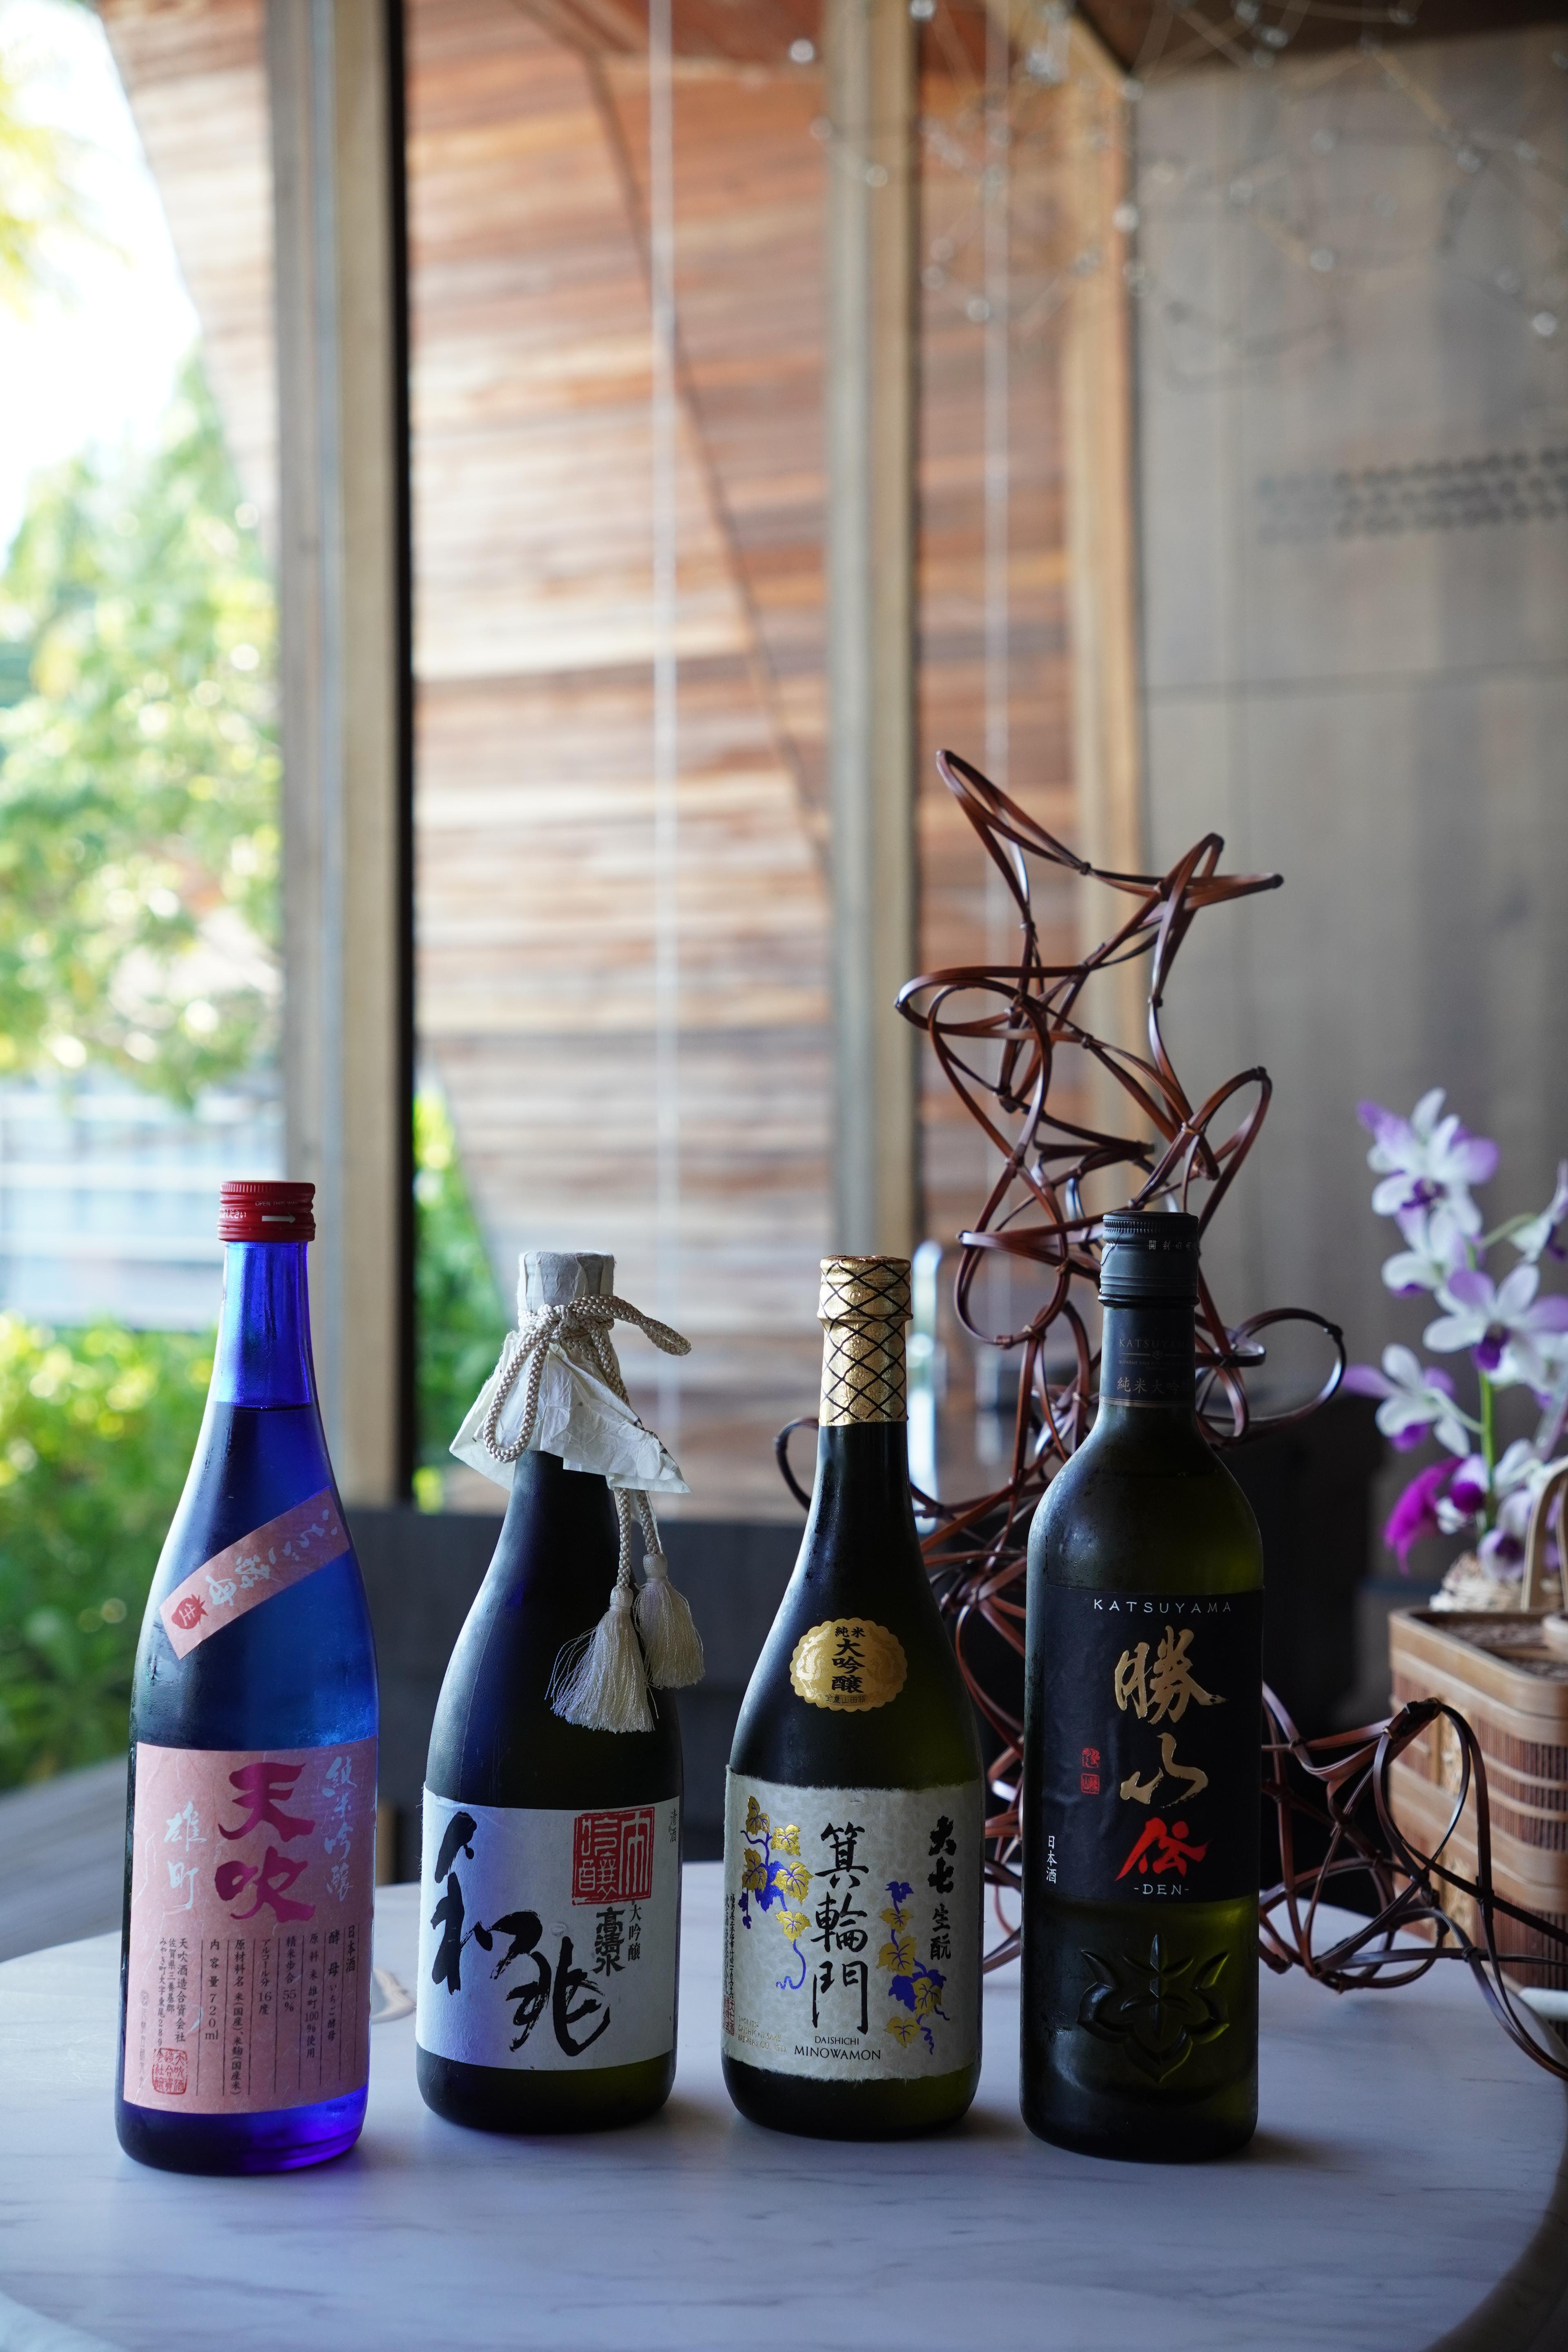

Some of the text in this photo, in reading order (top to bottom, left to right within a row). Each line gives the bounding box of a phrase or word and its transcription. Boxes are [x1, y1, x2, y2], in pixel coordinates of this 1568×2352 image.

[179, 1603, 196, 1627] 生
[1094, 1599, 1232, 1614] KATSUYAMA
[835, 1627, 866, 1638] 純米
[832, 1638, 866, 1693] 大吟醸
[214, 1762, 316, 1923] 天吹
[670, 1808, 677, 1842] 清酒
[163, 1801, 207, 1909] 雄町
[928, 1815, 957, 1894] 大七
[1046, 1835, 1057, 1884] 日本酒
[345, 1925, 356, 1972] 日本酒
[591, 1907, 627, 1976] 高清水
[628, 1904, 642, 1961] 大吟醸
[811, 1822, 869, 2034] 箕輪門
[175, 1938, 189, 2043] 天吹酒造合資会社
[738, 2025, 764, 2039] DAISHICHI
[794, 2045, 881, 2060] MINOWAMON
[815, 2036, 859, 2045] DAISHICHI
